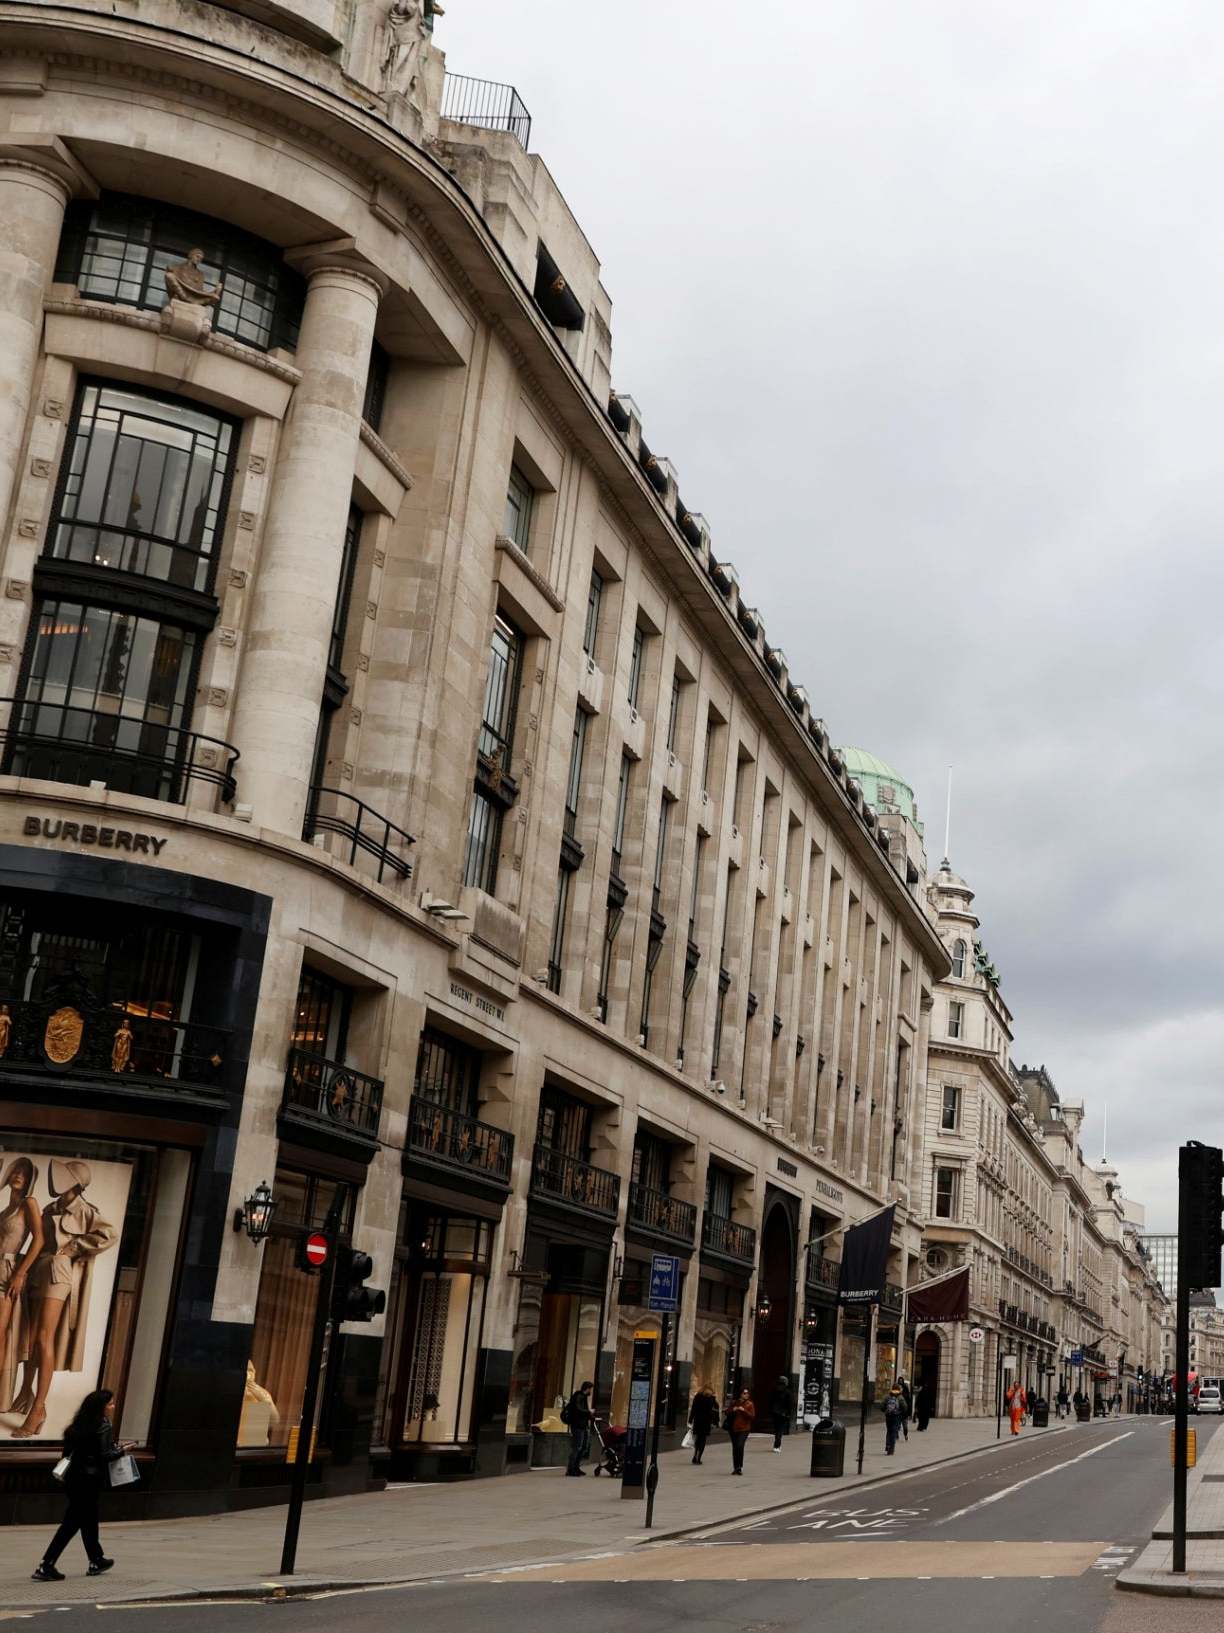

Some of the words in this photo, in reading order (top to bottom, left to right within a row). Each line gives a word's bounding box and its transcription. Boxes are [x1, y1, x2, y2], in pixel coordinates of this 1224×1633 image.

[23, 816, 168, 856] BURBERRY
[450, 983, 473, 1004] REGENT
[475, 997, 496, 1017] STREET
[840, 1289, 879, 1298] BURBERRY
[802, 1509, 930, 1517] BUS
